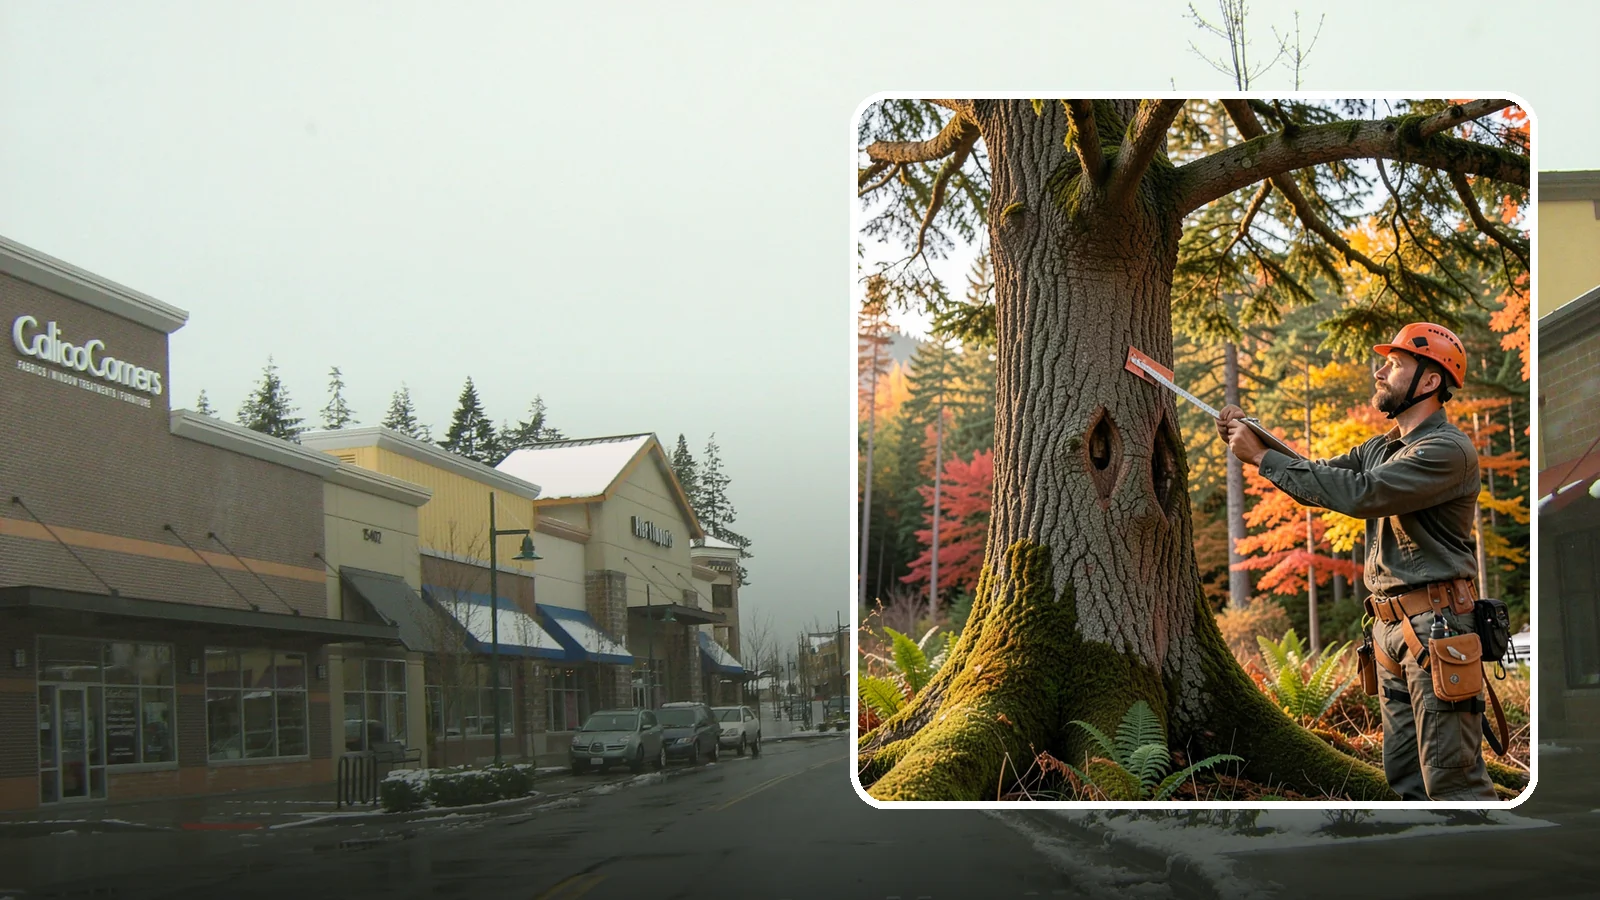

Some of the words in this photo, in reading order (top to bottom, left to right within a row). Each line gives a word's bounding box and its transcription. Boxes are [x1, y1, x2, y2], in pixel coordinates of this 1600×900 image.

[17, 360, 47, 377] FABRICS
[51, 370, 78, 387] WINDOW
[78, 378, 117, 398] TREATMENTS
[120, 391, 152, 409] FURNITURE
